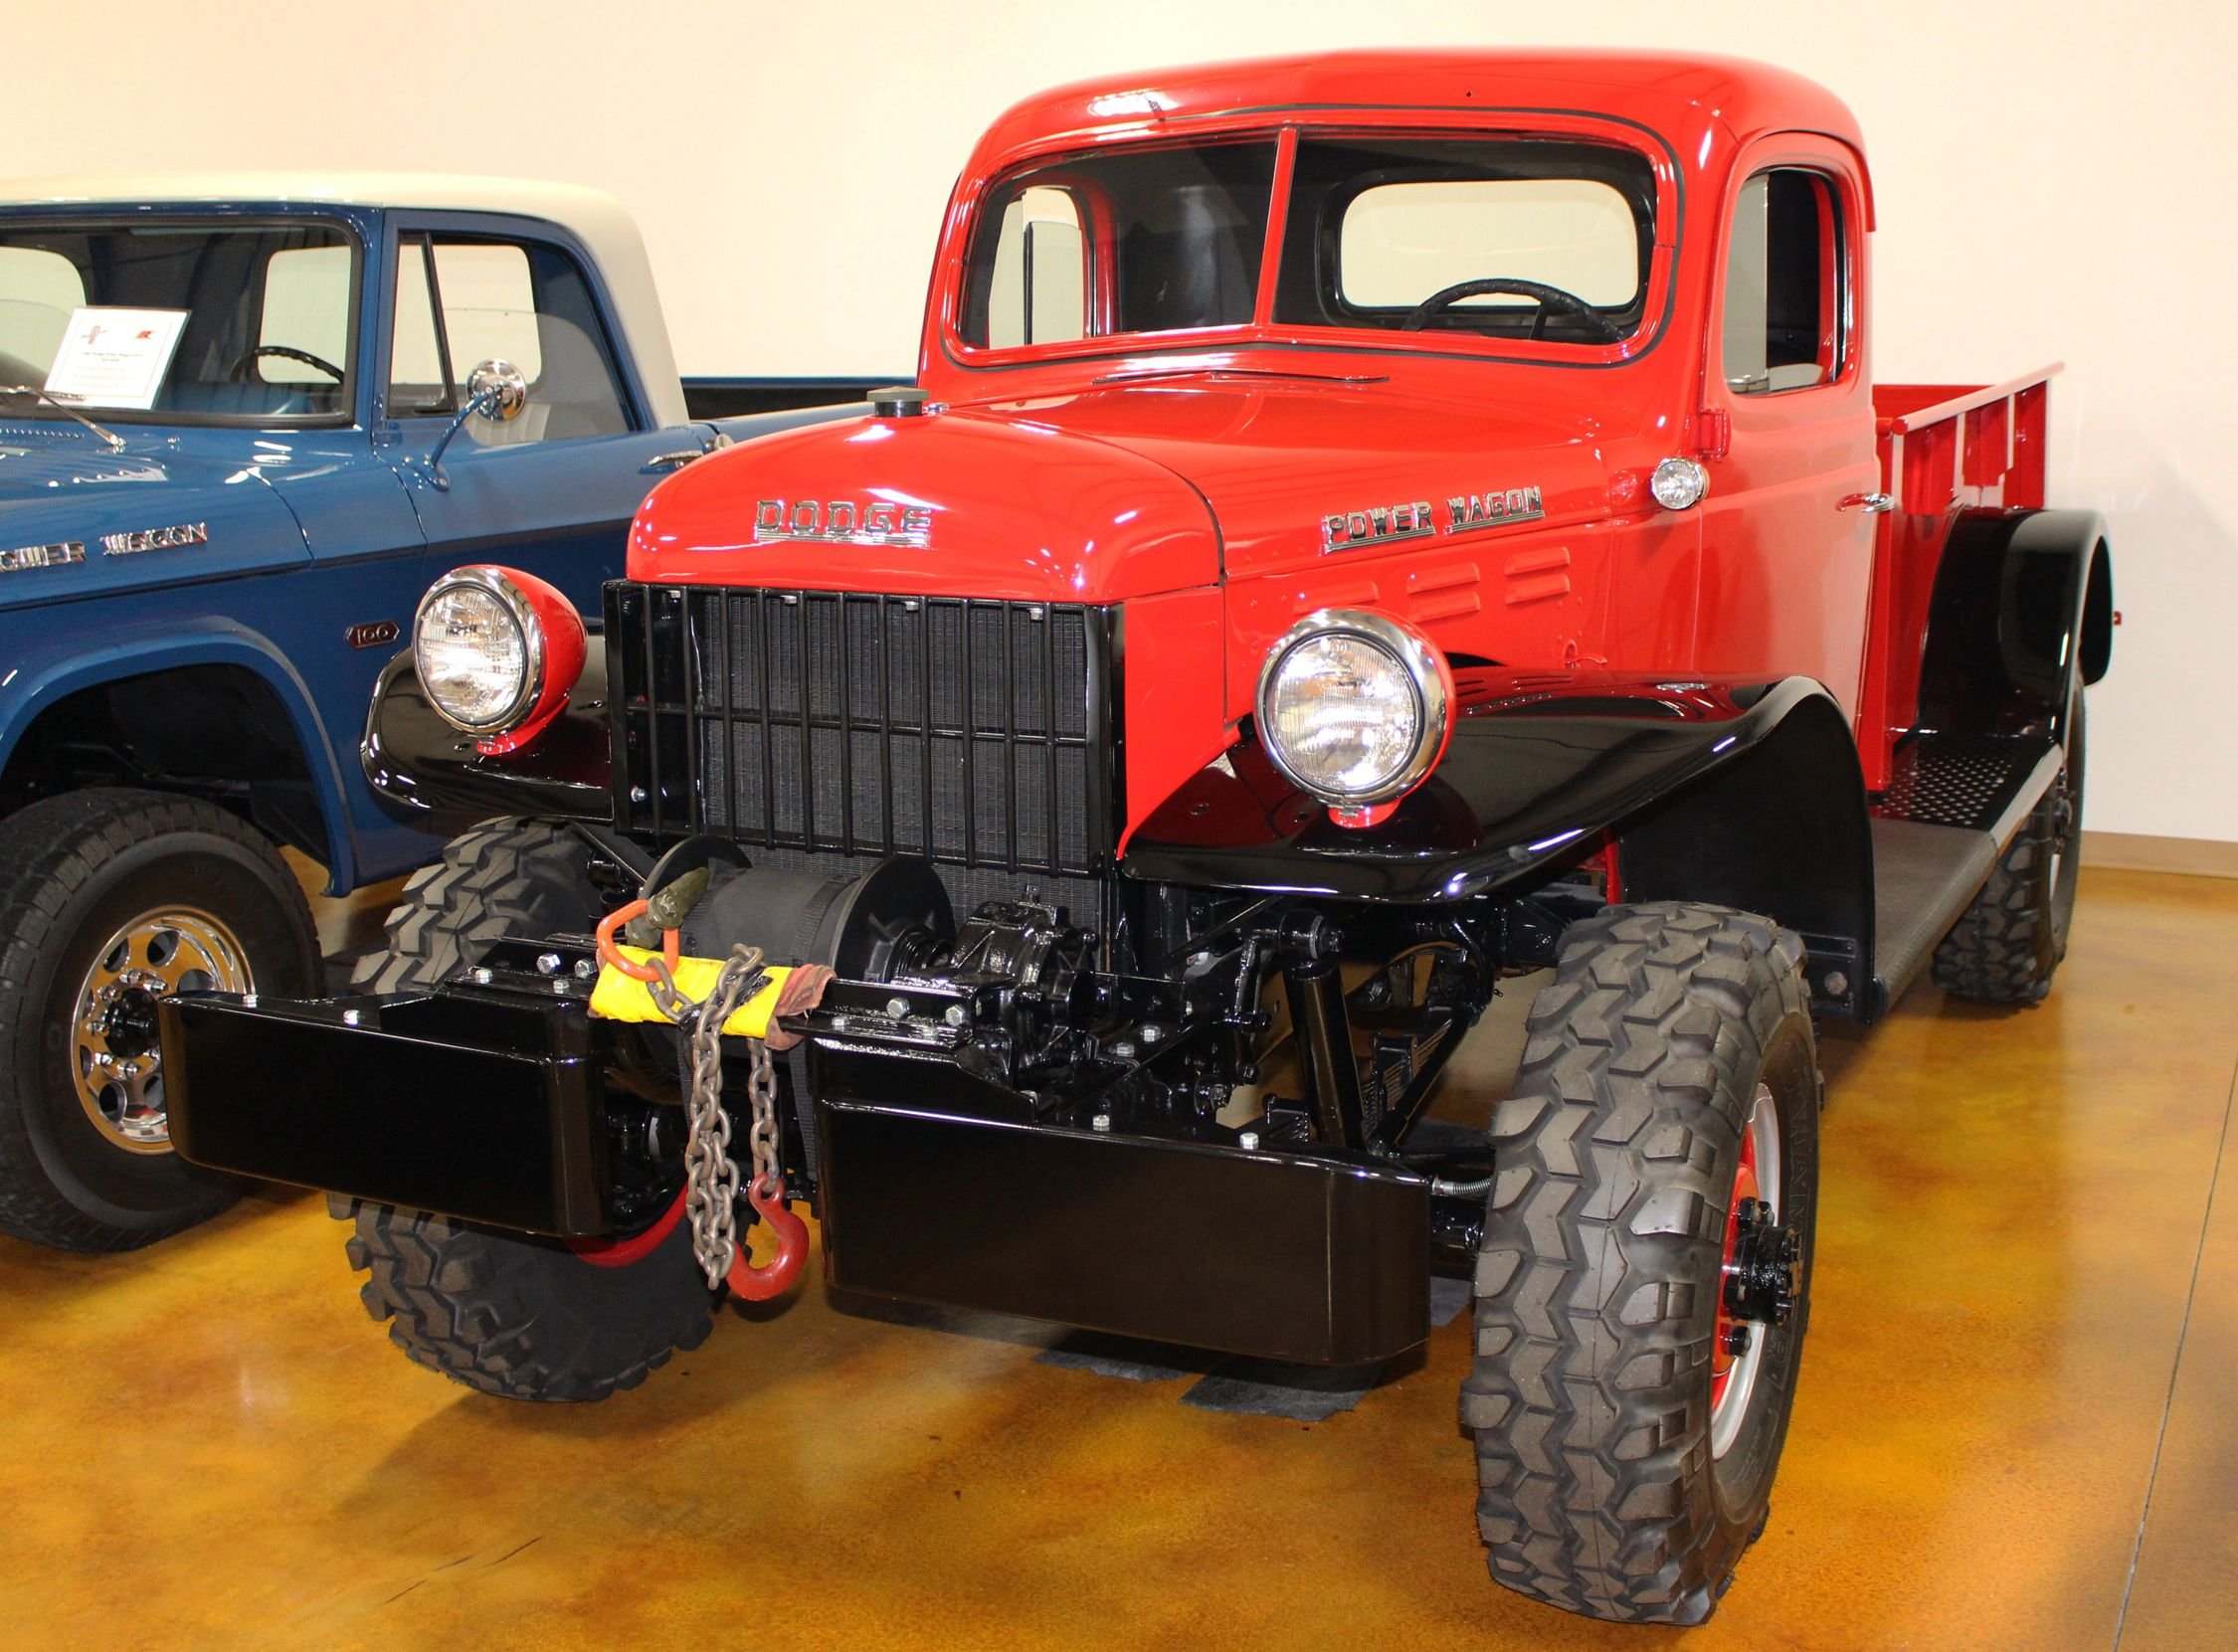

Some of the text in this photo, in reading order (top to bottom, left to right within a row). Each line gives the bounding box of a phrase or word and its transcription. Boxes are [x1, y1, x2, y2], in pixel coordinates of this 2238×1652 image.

[755, 500, 932, 534] DODGE
[1323, 485, 1542, 544] POWER WAGON
[0, 541, 86, 572] OWER
